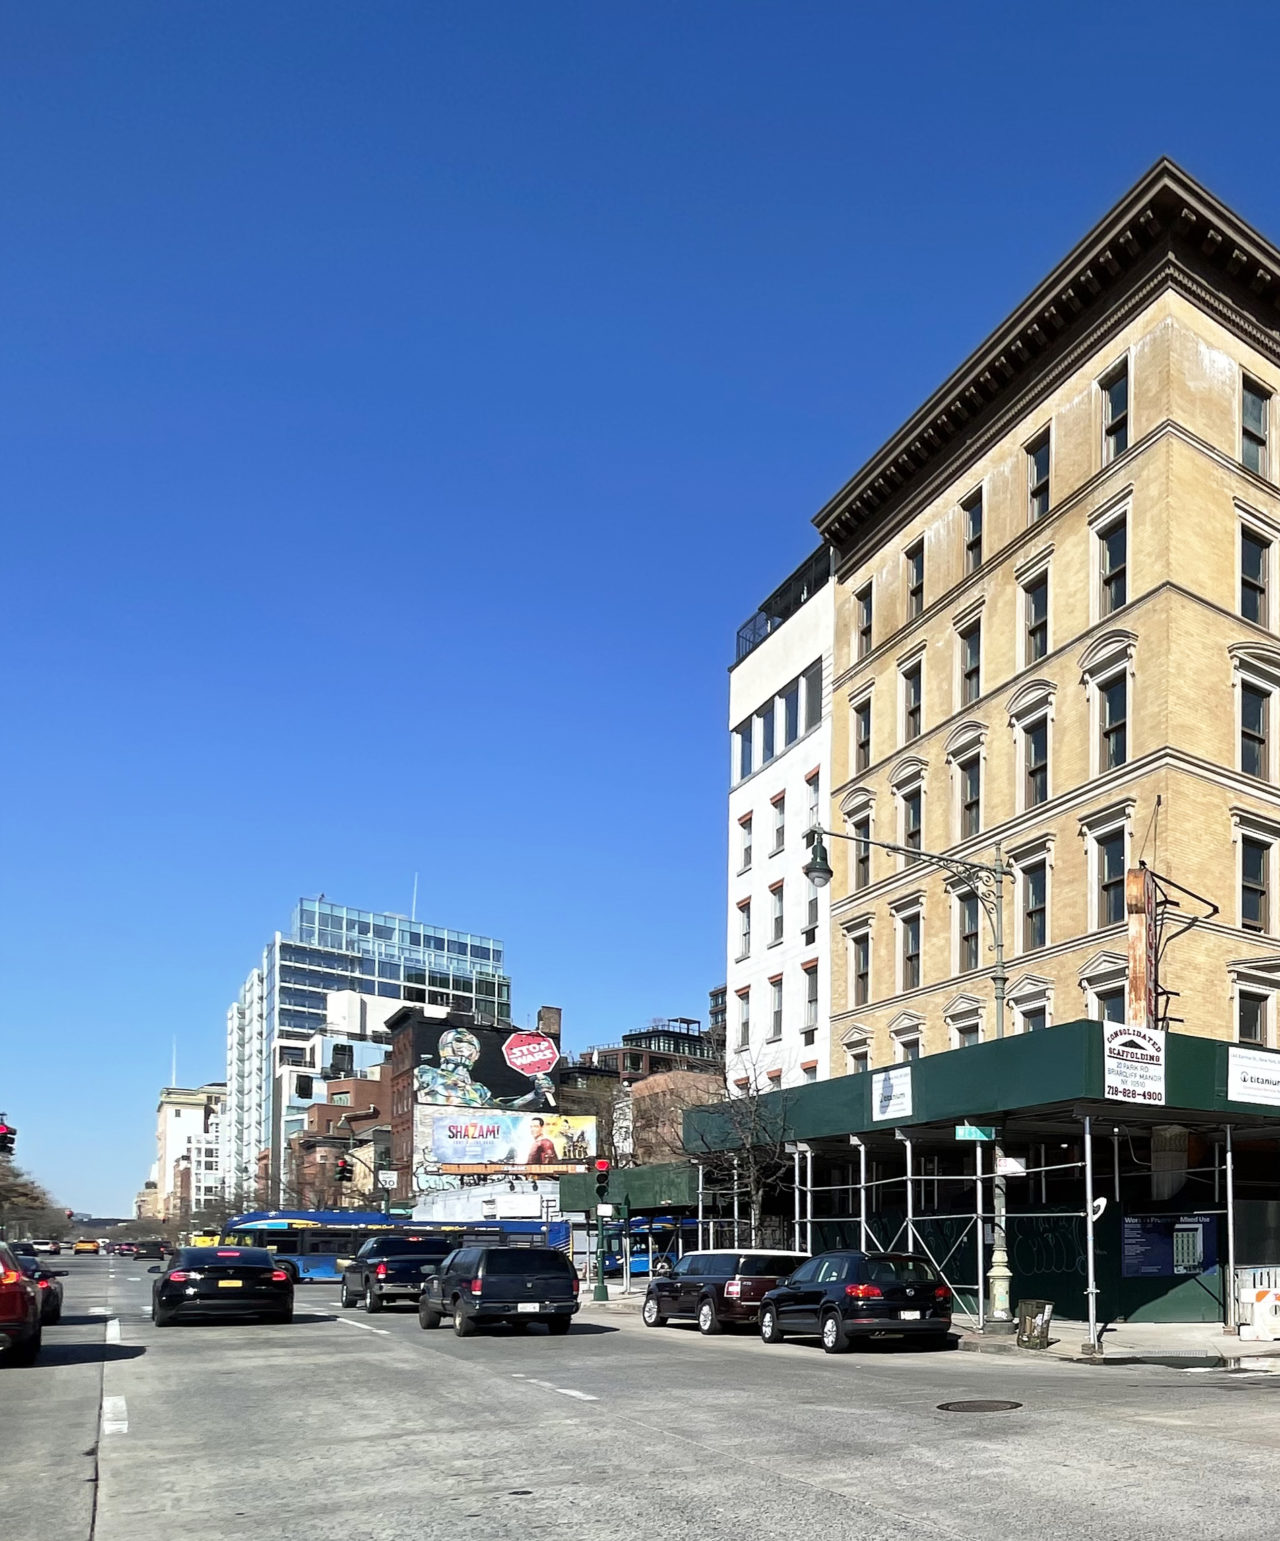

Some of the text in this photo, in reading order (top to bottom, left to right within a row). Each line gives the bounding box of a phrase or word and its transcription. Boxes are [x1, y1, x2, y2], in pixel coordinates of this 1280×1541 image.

[1107, 1028, 1162, 1053] CONSOLIDATED
[509, 1041, 549, 1058] STOP
[510, 1049, 553, 1065] WARS
[1108, 1047, 1160, 1062] SCAFFOLDING
[1107, 1085, 1162, 1101] 718-828-4900
[448, 1122, 500, 1139] SHAZAM!
[381, 1179, 395, 1187] 30
